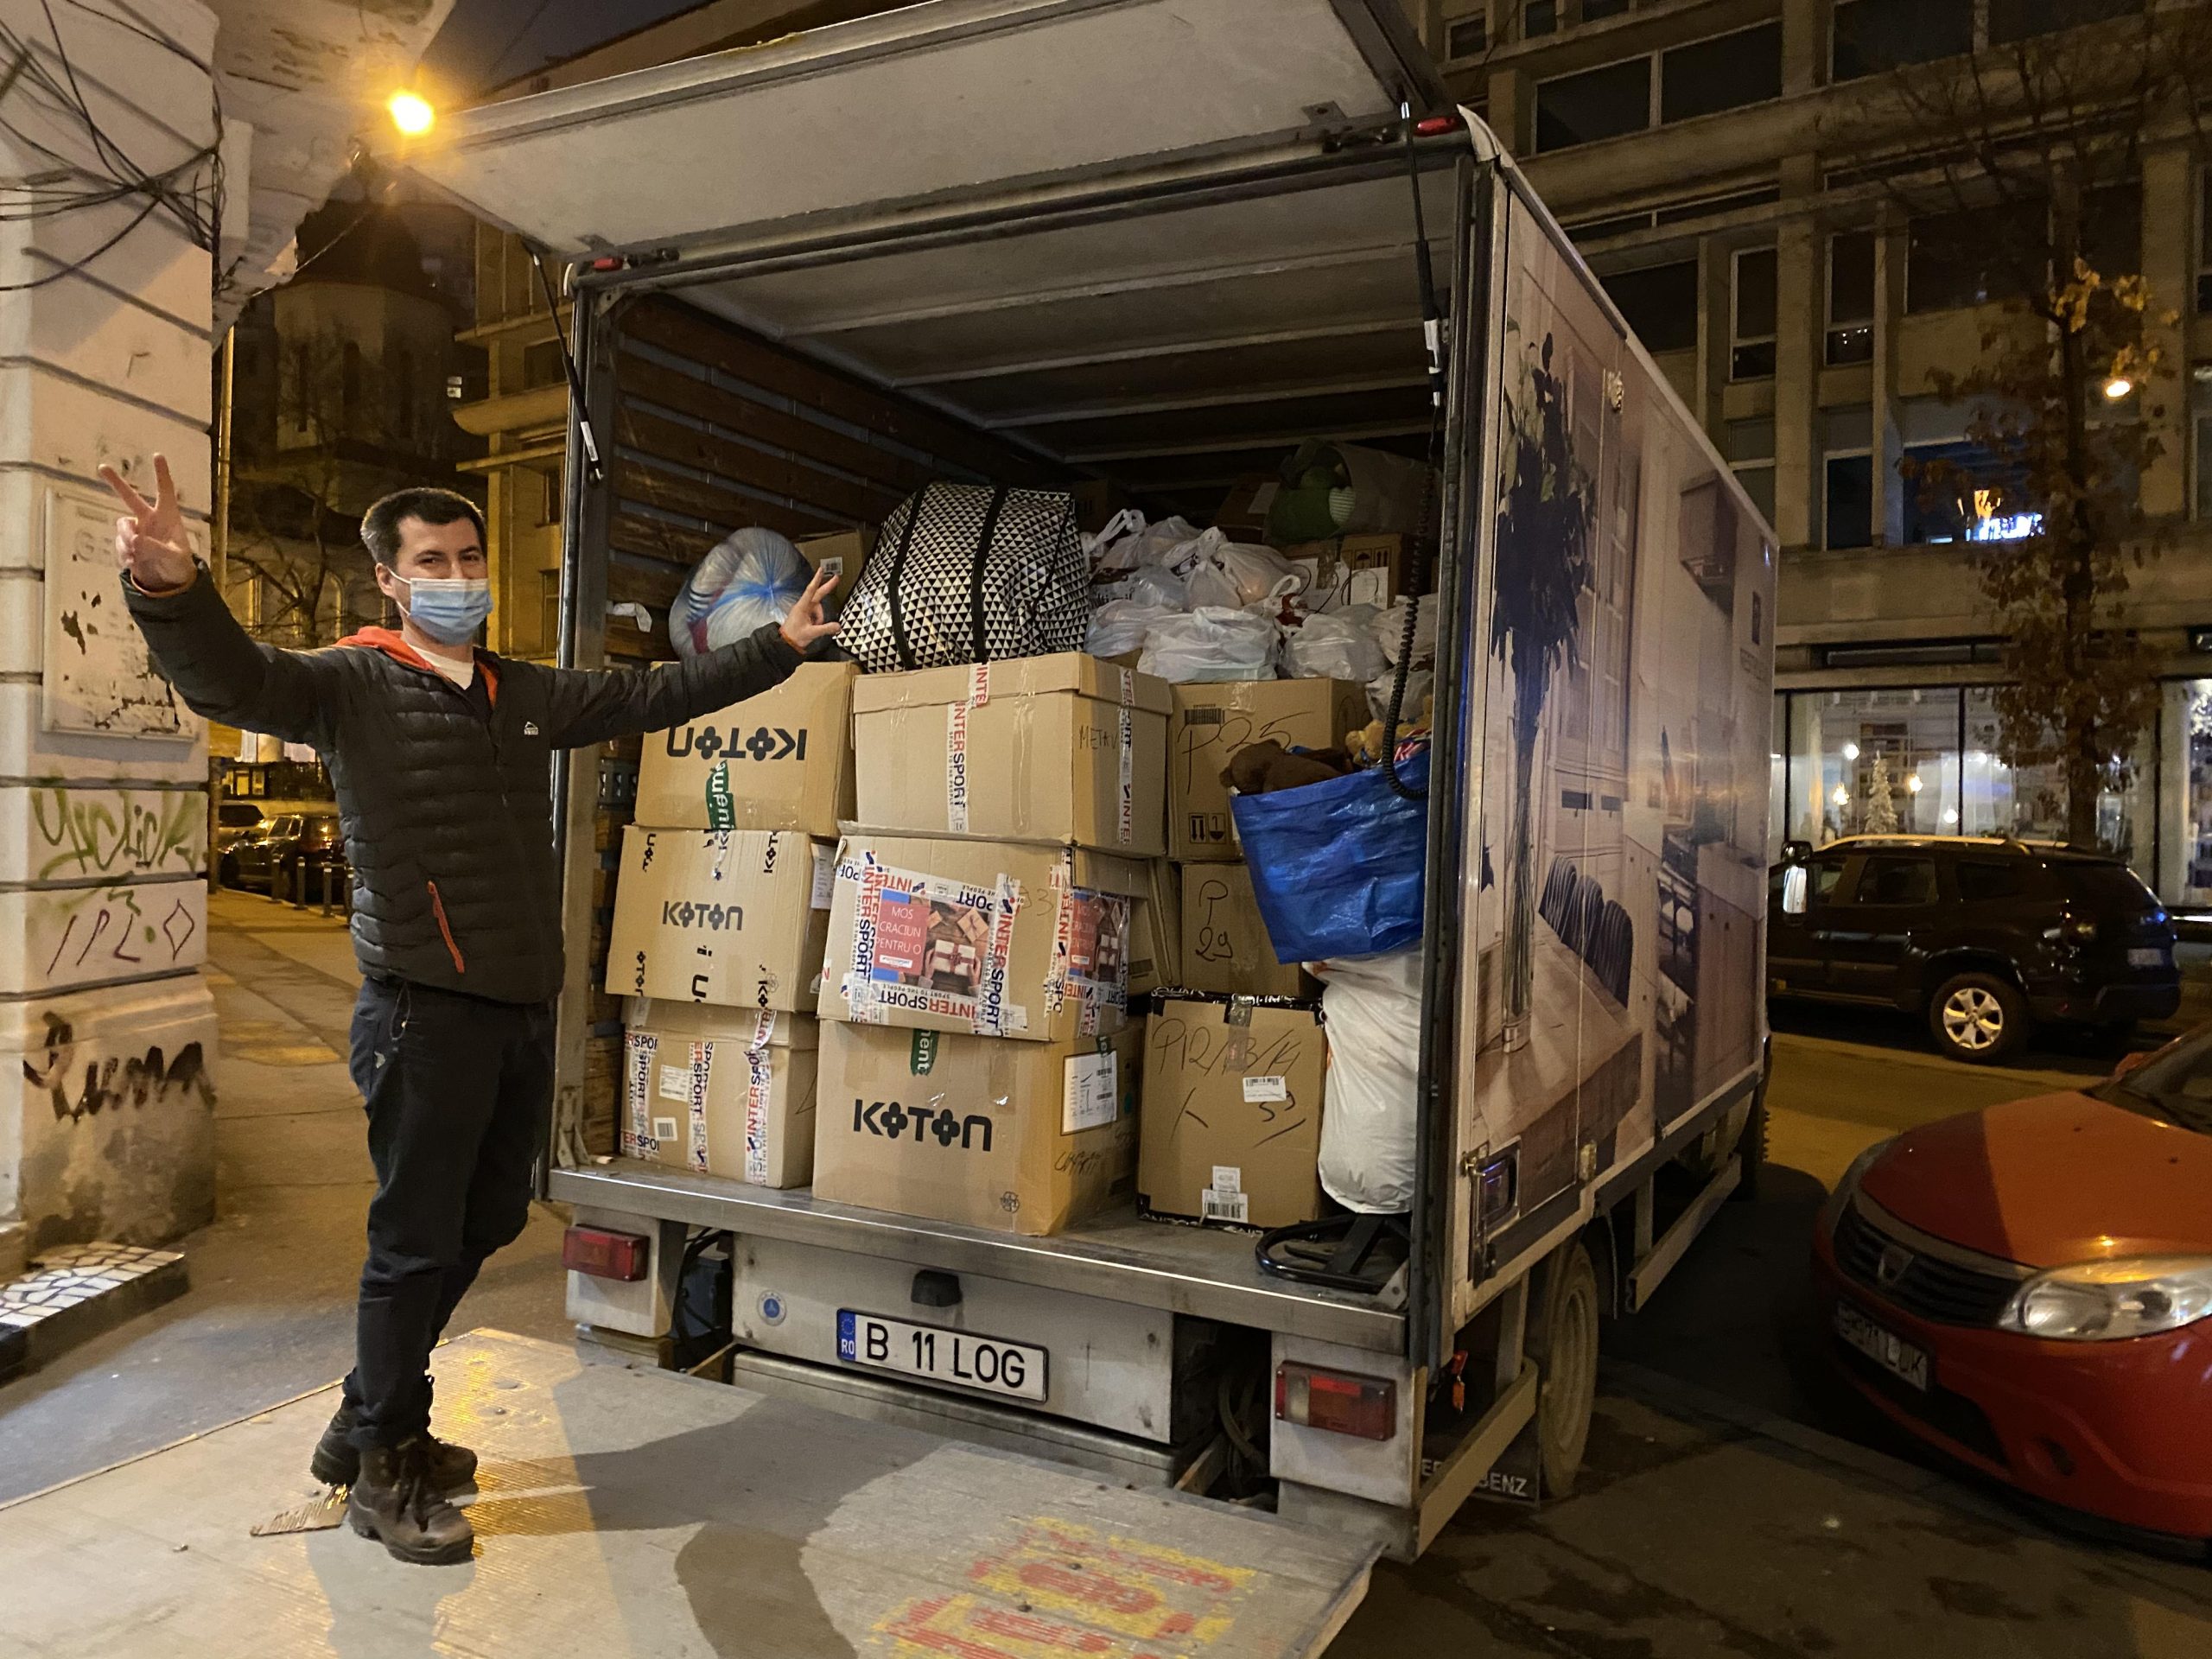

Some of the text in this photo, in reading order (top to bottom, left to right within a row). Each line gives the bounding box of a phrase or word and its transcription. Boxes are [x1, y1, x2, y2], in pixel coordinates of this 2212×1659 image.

[666, 726, 808, 761] KOTON
[952, 701, 966, 809] INTERSPORT
[662, 900, 744, 931] KOTON
[855, 866, 875, 979] INTERSPORT
[879, 921, 921, 938] CRACIUN
[892, 906, 914, 920] MOS
[875, 938, 922, 955] PENTRU O
[986, 914, 1013, 1027] INTERSPORT
[879, 990, 976, 1020] INTERSPORT
[852, 1099, 993, 1152] KOTON
[841, 1322, 1025, 1388] RO B 11 LOG
